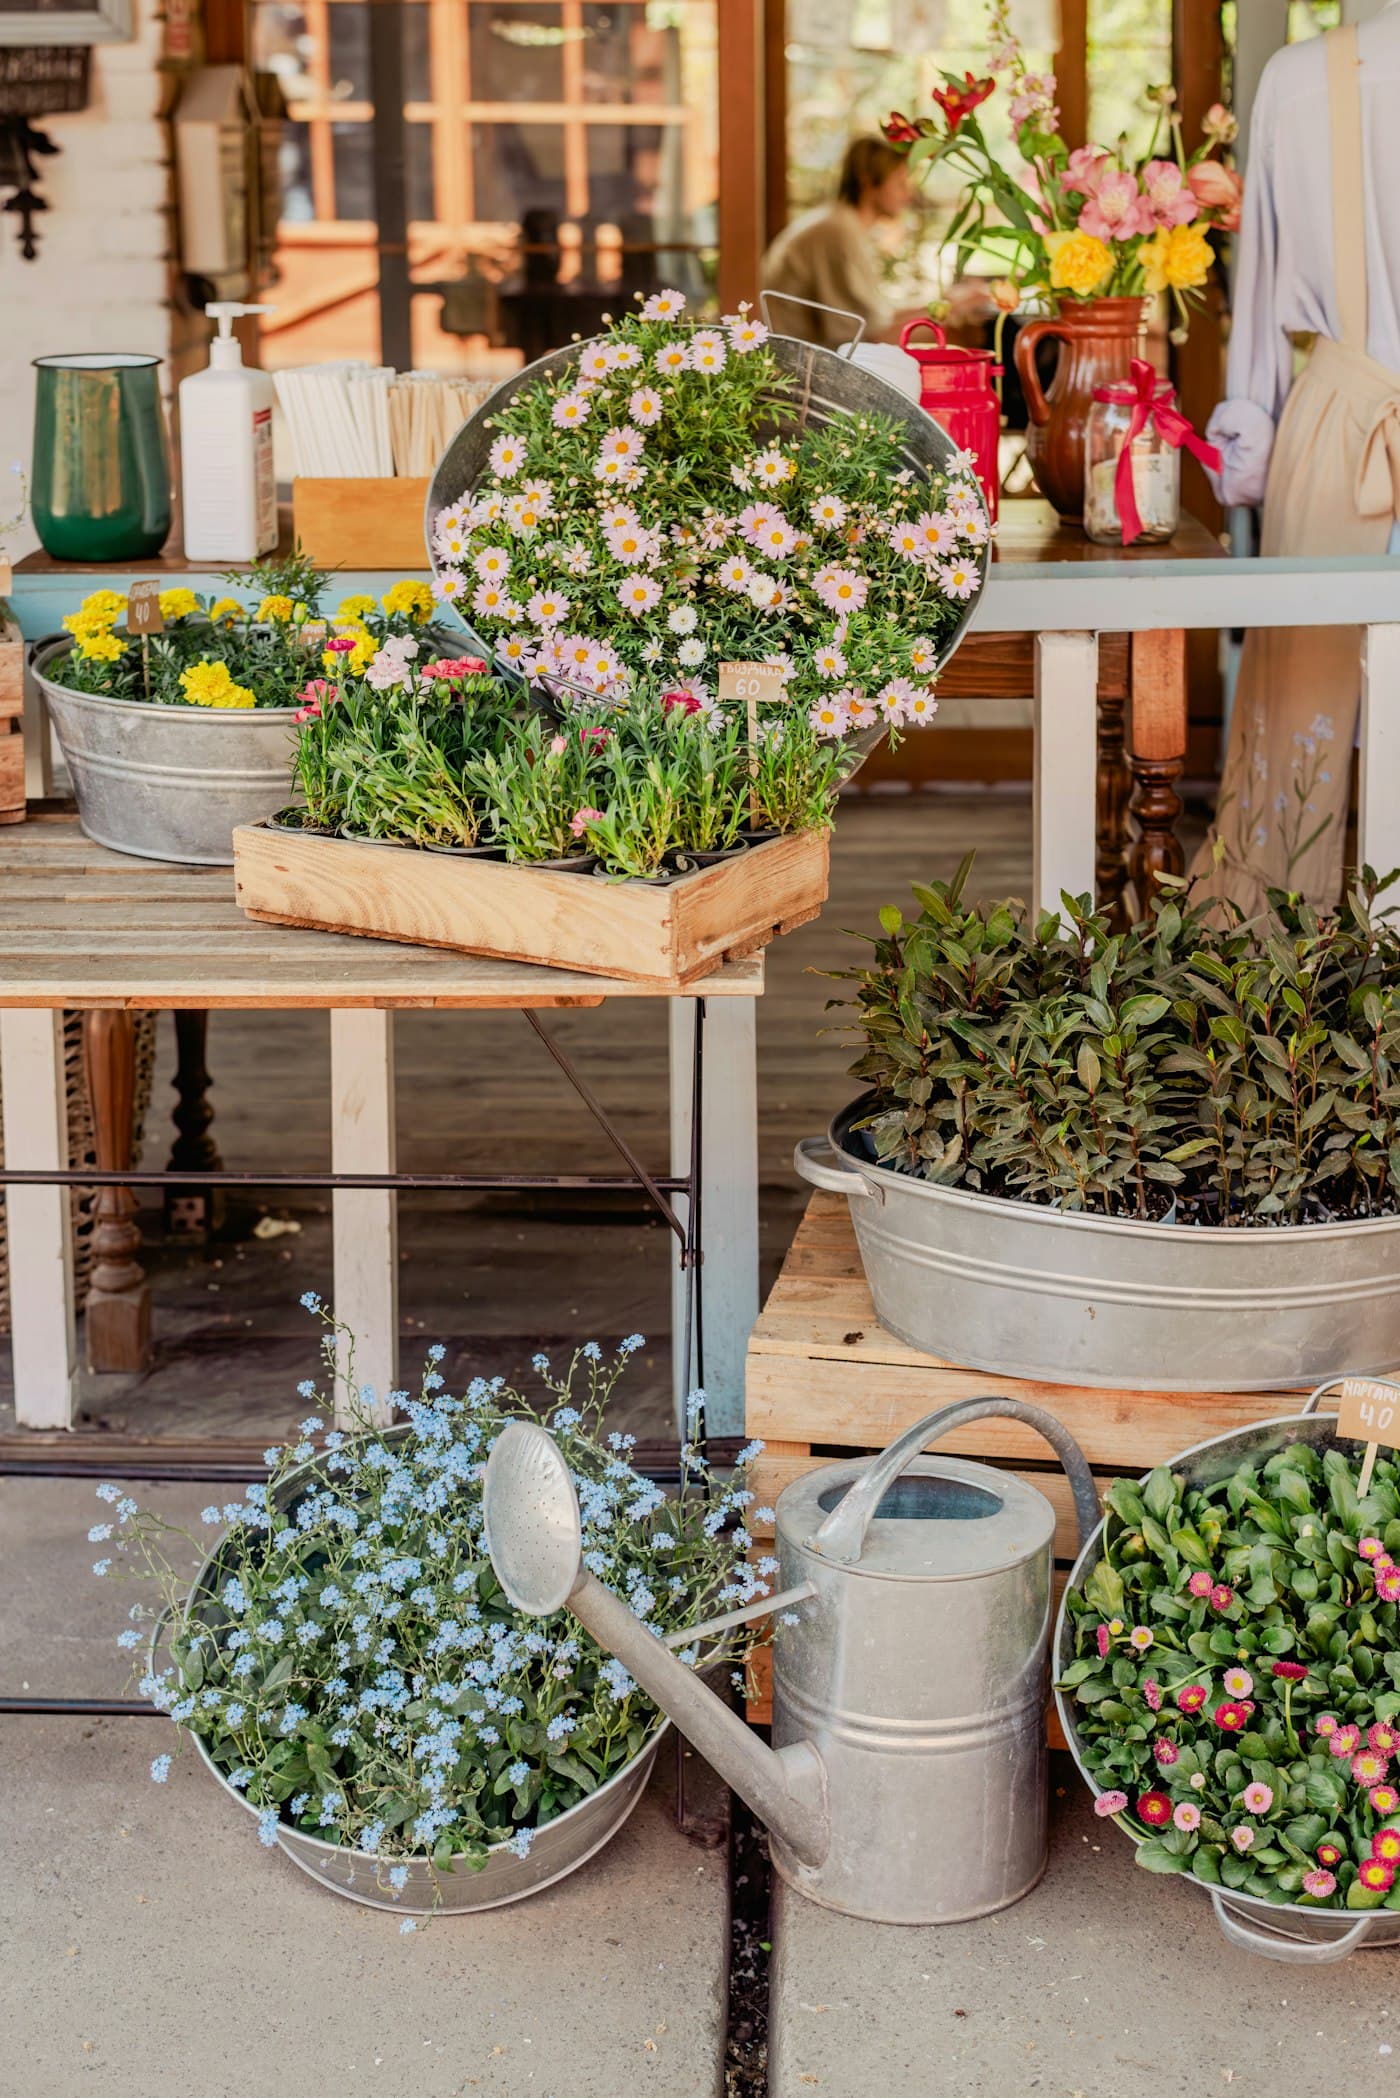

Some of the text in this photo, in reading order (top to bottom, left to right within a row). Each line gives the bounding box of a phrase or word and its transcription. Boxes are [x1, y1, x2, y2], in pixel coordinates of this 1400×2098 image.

[735, 678, 761, 696] 60
[1343, 1379, 1400, 1404] МАРГАРИ
[1359, 1401, 1394, 1430] 40
